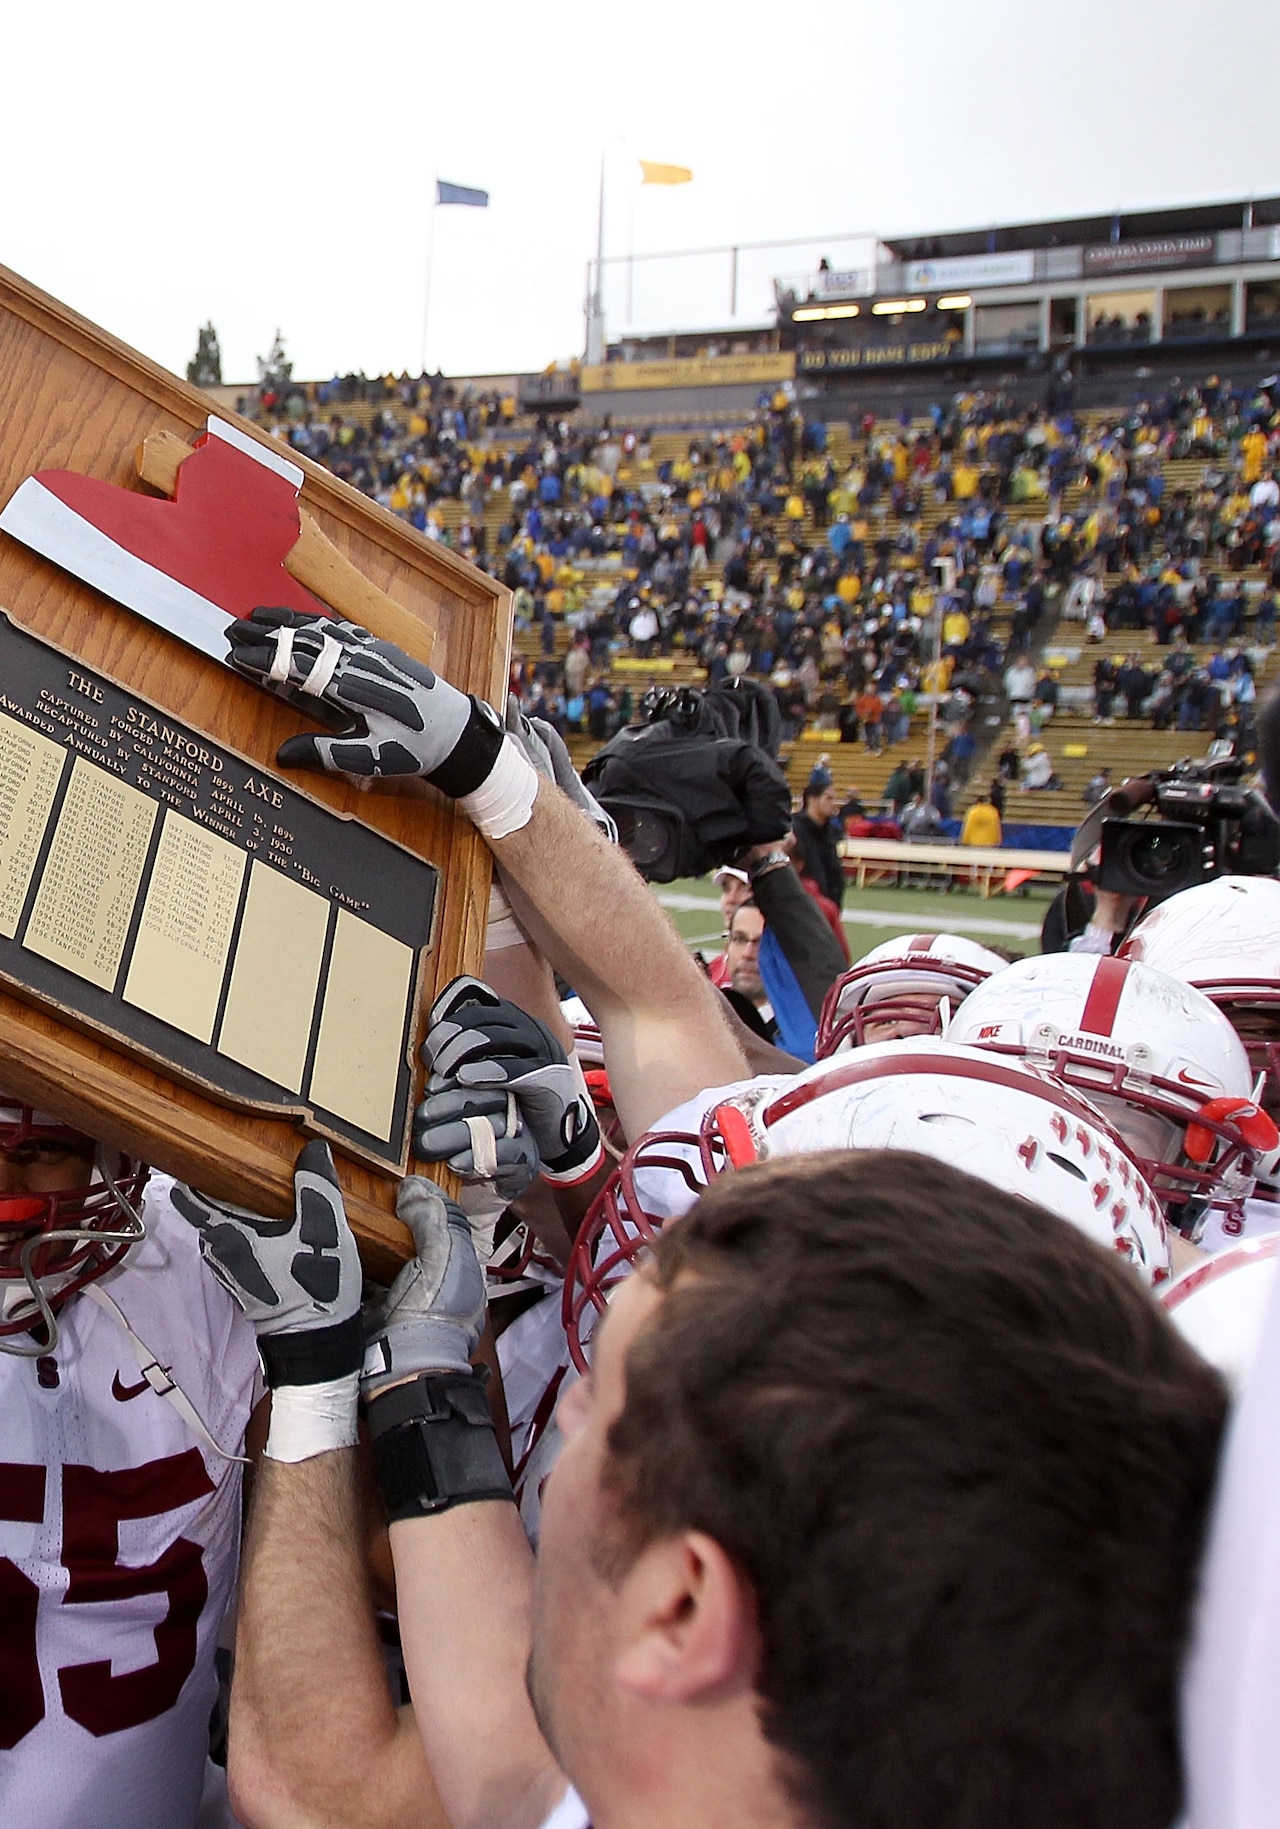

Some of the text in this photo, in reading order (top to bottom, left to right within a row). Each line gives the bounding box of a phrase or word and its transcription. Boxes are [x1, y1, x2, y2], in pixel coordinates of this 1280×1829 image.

[64, 669, 285, 811] THE STANFORD AXE
[38, 687, 99, 729] CAPTURED
[108, 727, 123, 744] BY
[131, 741, 199, 788] CALIFORNIA
[210, 787, 246, 815] APRIL
[272, 823, 295, 844] 1899
[109, 714, 235, 796] FORGED MARCH 1899
[34, 699, 109, 749] RECAPTURED
[115, 746, 131, 762] BY
[140, 761, 198, 801] STANFORD
[209, 801, 244, 829] APRIL
[269, 835, 293, 857] 1930
[92, 778, 126, 803] STANFORD
[90, 786, 124, 810] STANFORD
[86, 800, 125, 827] CALIFORNIA
[82, 815, 117, 840] STANFORD
[184, 831, 214, 853] STANFORD
[69, 861, 105, 887] STANFORD
[63, 885, 99, 910] STANFORD
[58, 901, 95, 927] STANFORD
[166, 912, 197, 934] STANFORD
[49, 934, 86, 960] STANFORD
[978, 1024, 1003, 1040] NIKE
[1057, 1034, 1126, 1060] CARDINAL
[1222, 1209, 1246, 1237] S
[36, 1356, 61, 1389] S
